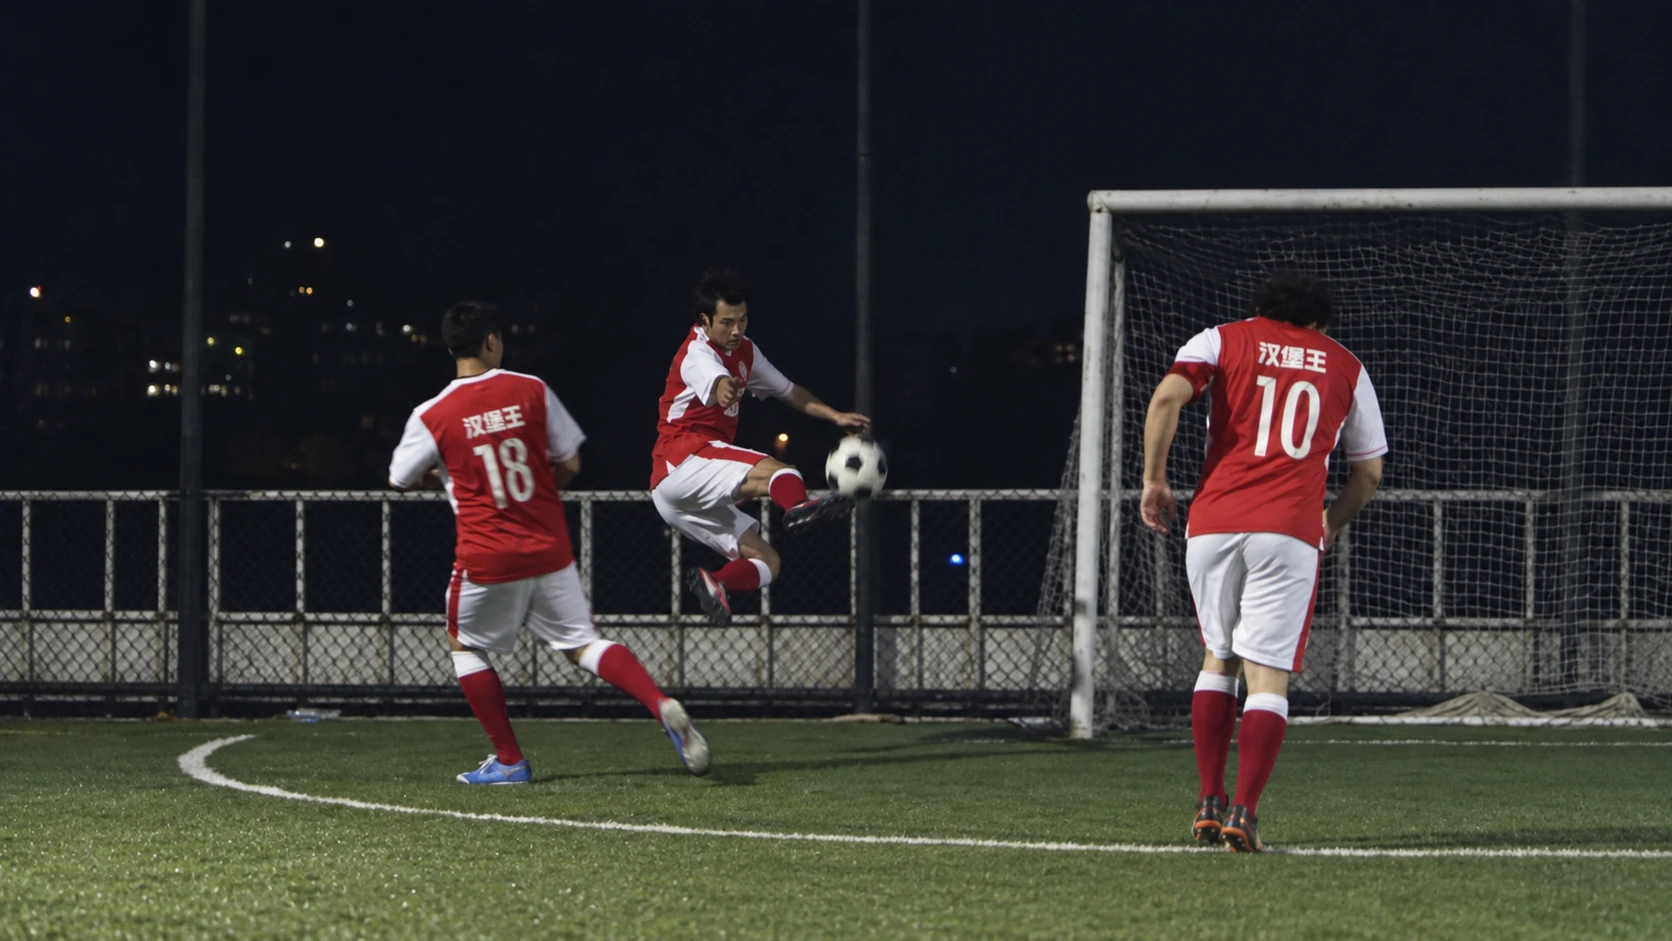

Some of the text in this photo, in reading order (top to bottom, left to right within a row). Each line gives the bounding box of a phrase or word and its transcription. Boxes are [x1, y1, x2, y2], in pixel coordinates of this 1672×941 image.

[1257, 341, 1327, 374] 汉堡王
[462, 404, 526, 440] 汉堡王
[1254, 375, 1320, 459] 10
[473, 437, 535, 509] 18
